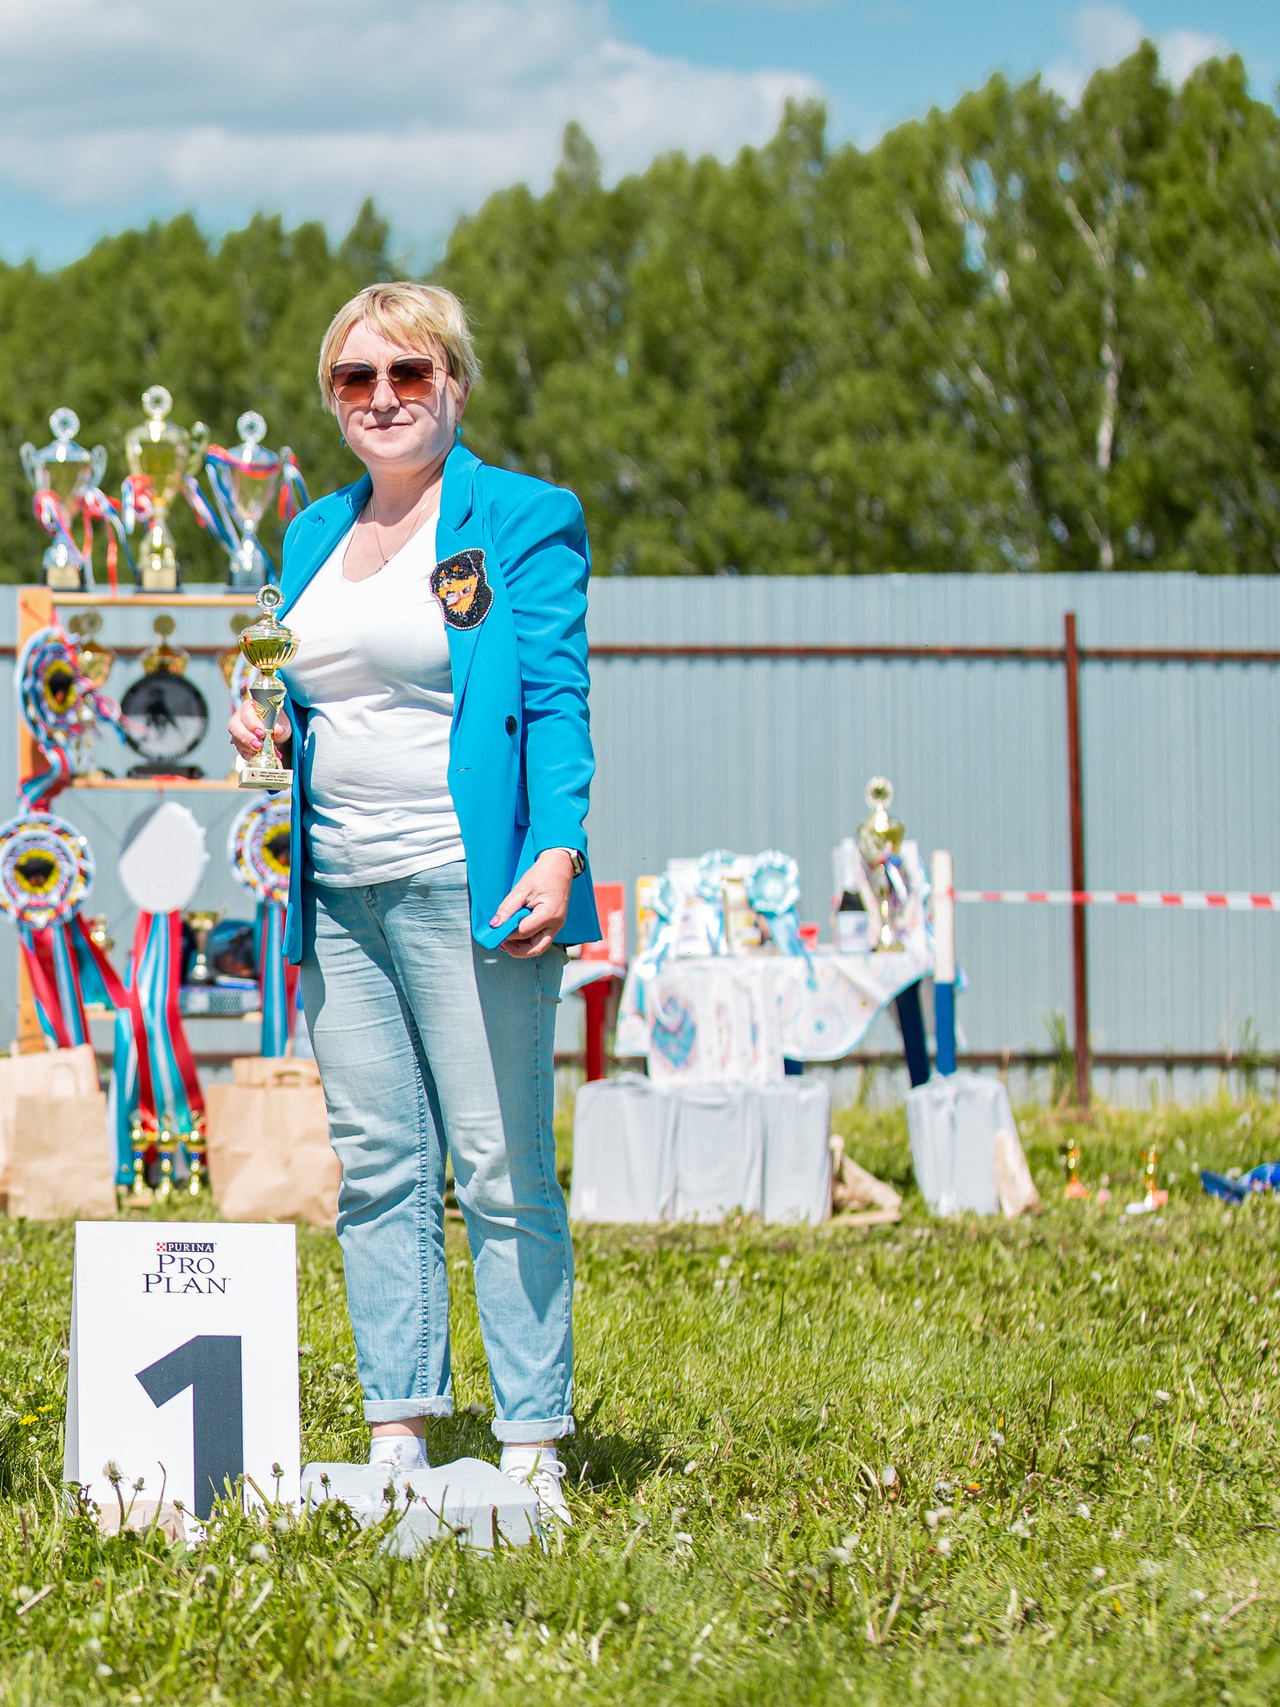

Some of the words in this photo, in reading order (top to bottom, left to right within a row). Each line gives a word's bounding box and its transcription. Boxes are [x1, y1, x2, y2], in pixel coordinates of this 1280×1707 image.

[167, 1242, 213, 1252] PURINA
[156, 1253, 215, 1275] PRO
[142, 1273, 228, 1294] PLAN
[134, 1335, 244, 1521] 1
